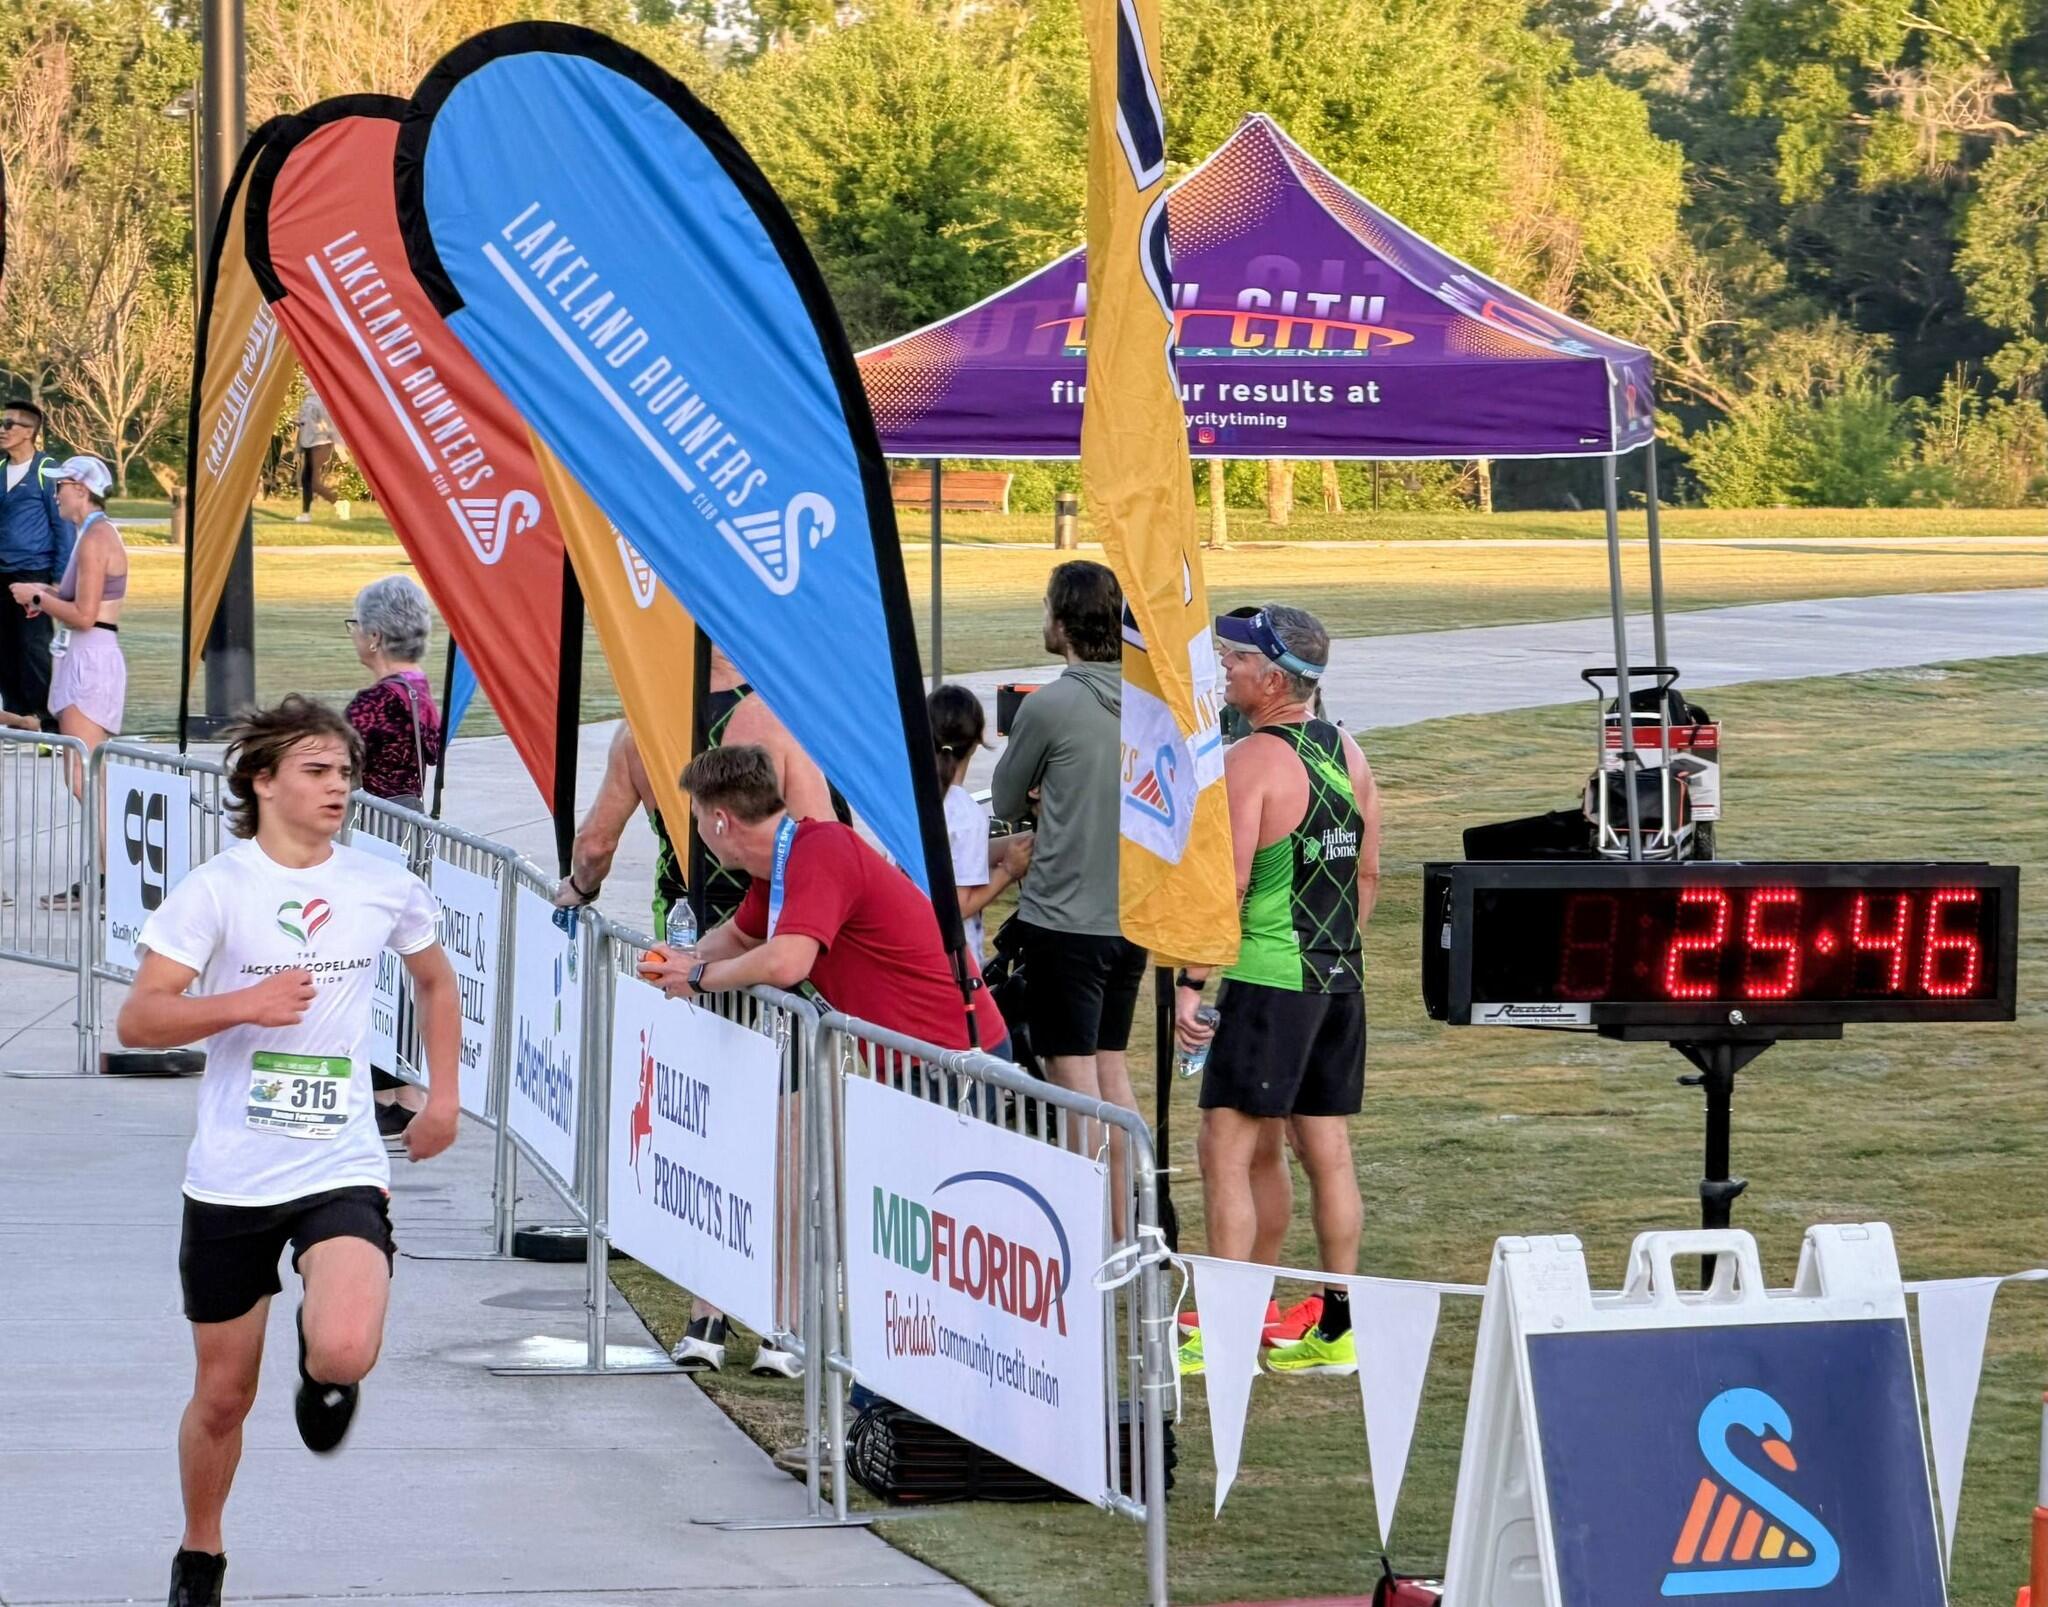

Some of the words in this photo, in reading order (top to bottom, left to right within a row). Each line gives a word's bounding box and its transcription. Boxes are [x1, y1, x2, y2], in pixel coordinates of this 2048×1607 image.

[241, 302, 274, 376] RUNNE
[323, 230, 422, 368] LAKELAND
[401, 366, 494, 490] RUNNERS
[501, 201, 649, 369] LAKELAND
[629, 355, 768, 508] RUNNERS
[1231, 348, 1364, 357] EVENTS
[1183, 411, 1287, 429] ycitytiming
[1219, 379, 1334, 403] results
[1347, 380, 1381, 403] at
[692, 492, 719, 521] CLUB
[303, 958, 372, 973] COPELAND
[475, 912, 486, 974] &
[291, 1078, 337, 1110] 315
[515, 1015, 573, 1137] AdventHealth
[656, 1062, 710, 1139] VALIANT
[654, 1153, 725, 1249] PRODUCTS,
[728, 1193, 754, 1260] INC.
[873, 1185, 1067, 1337] MIDFLORIDA
[885, 1290, 937, 1360] Florida's
[938, 1325, 995, 1388] community
[996, 1348, 1027, 1394] credit
[1029, 1360, 1059, 1408] union
